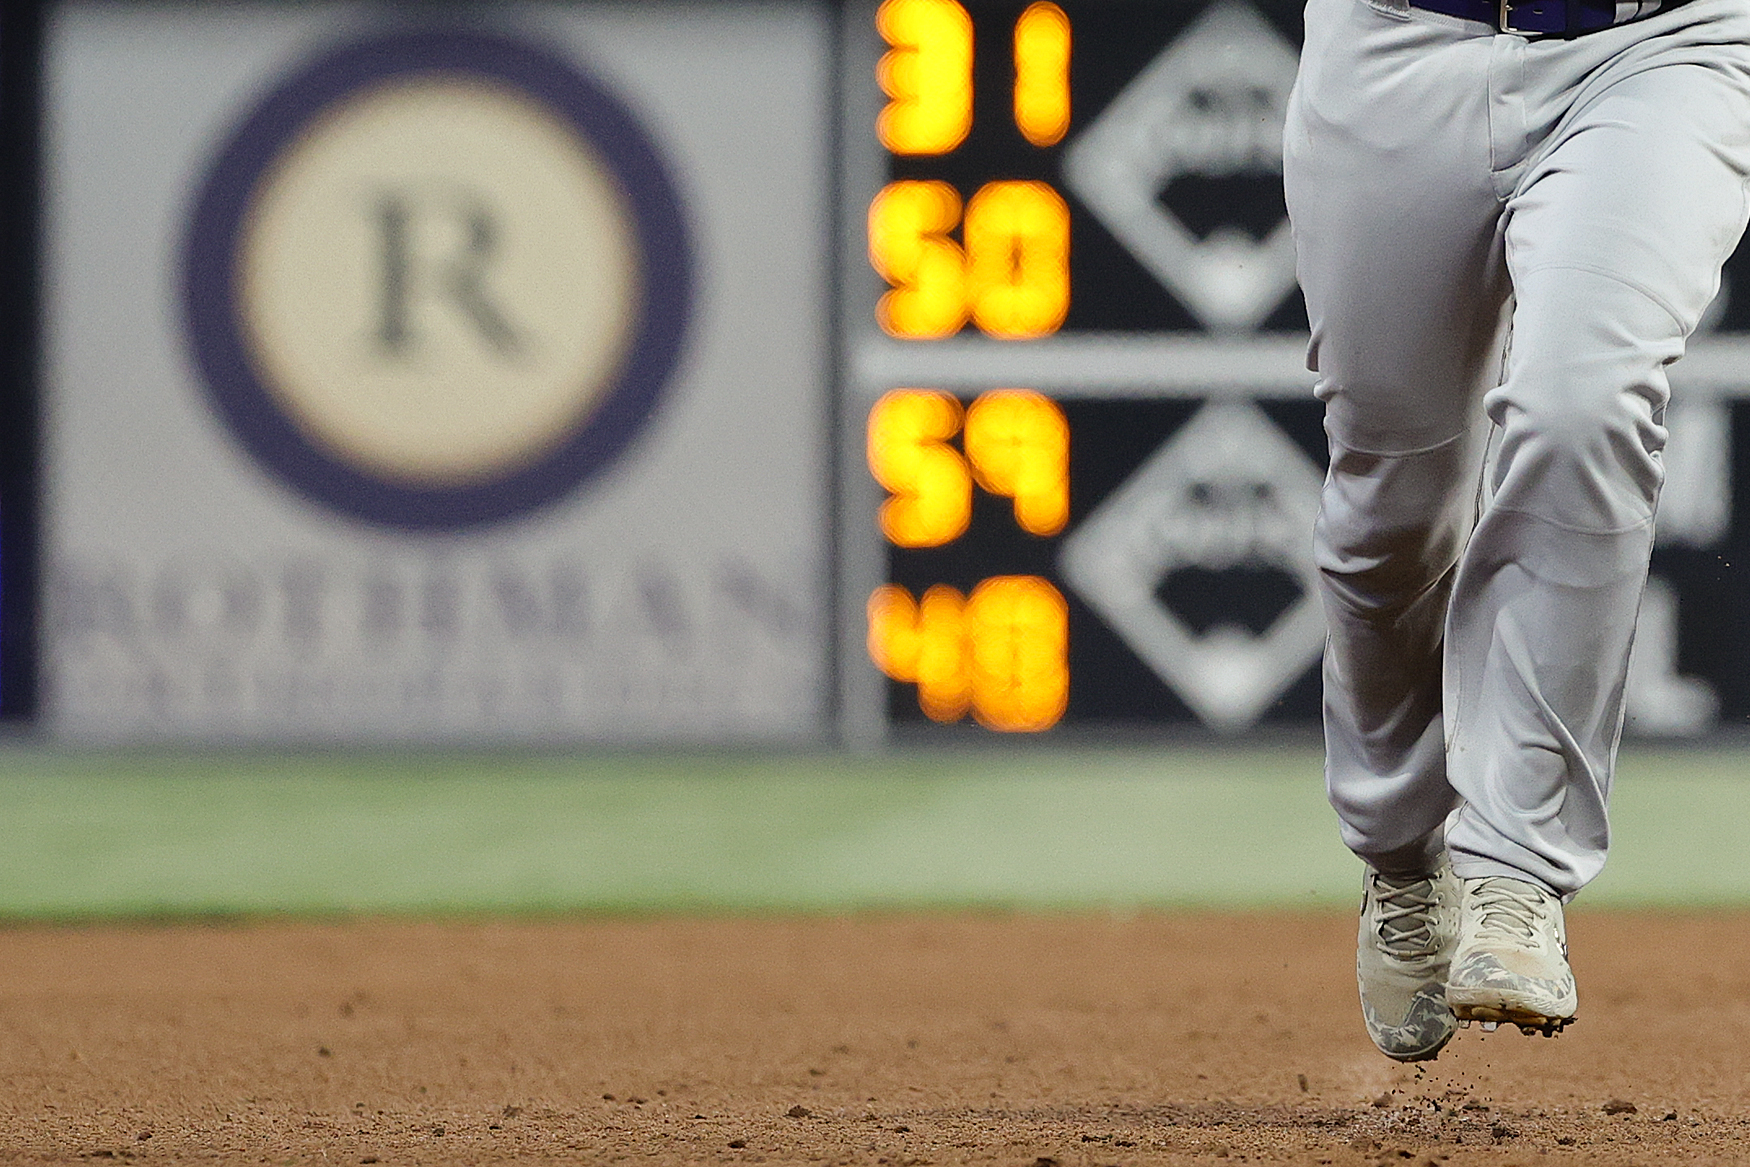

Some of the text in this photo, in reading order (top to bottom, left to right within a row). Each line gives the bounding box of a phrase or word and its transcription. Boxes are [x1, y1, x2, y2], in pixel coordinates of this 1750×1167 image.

[362, 183, 534, 363] R
[867, 179, 1072, 341] 50
[866, 387, 1071, 548] 59
